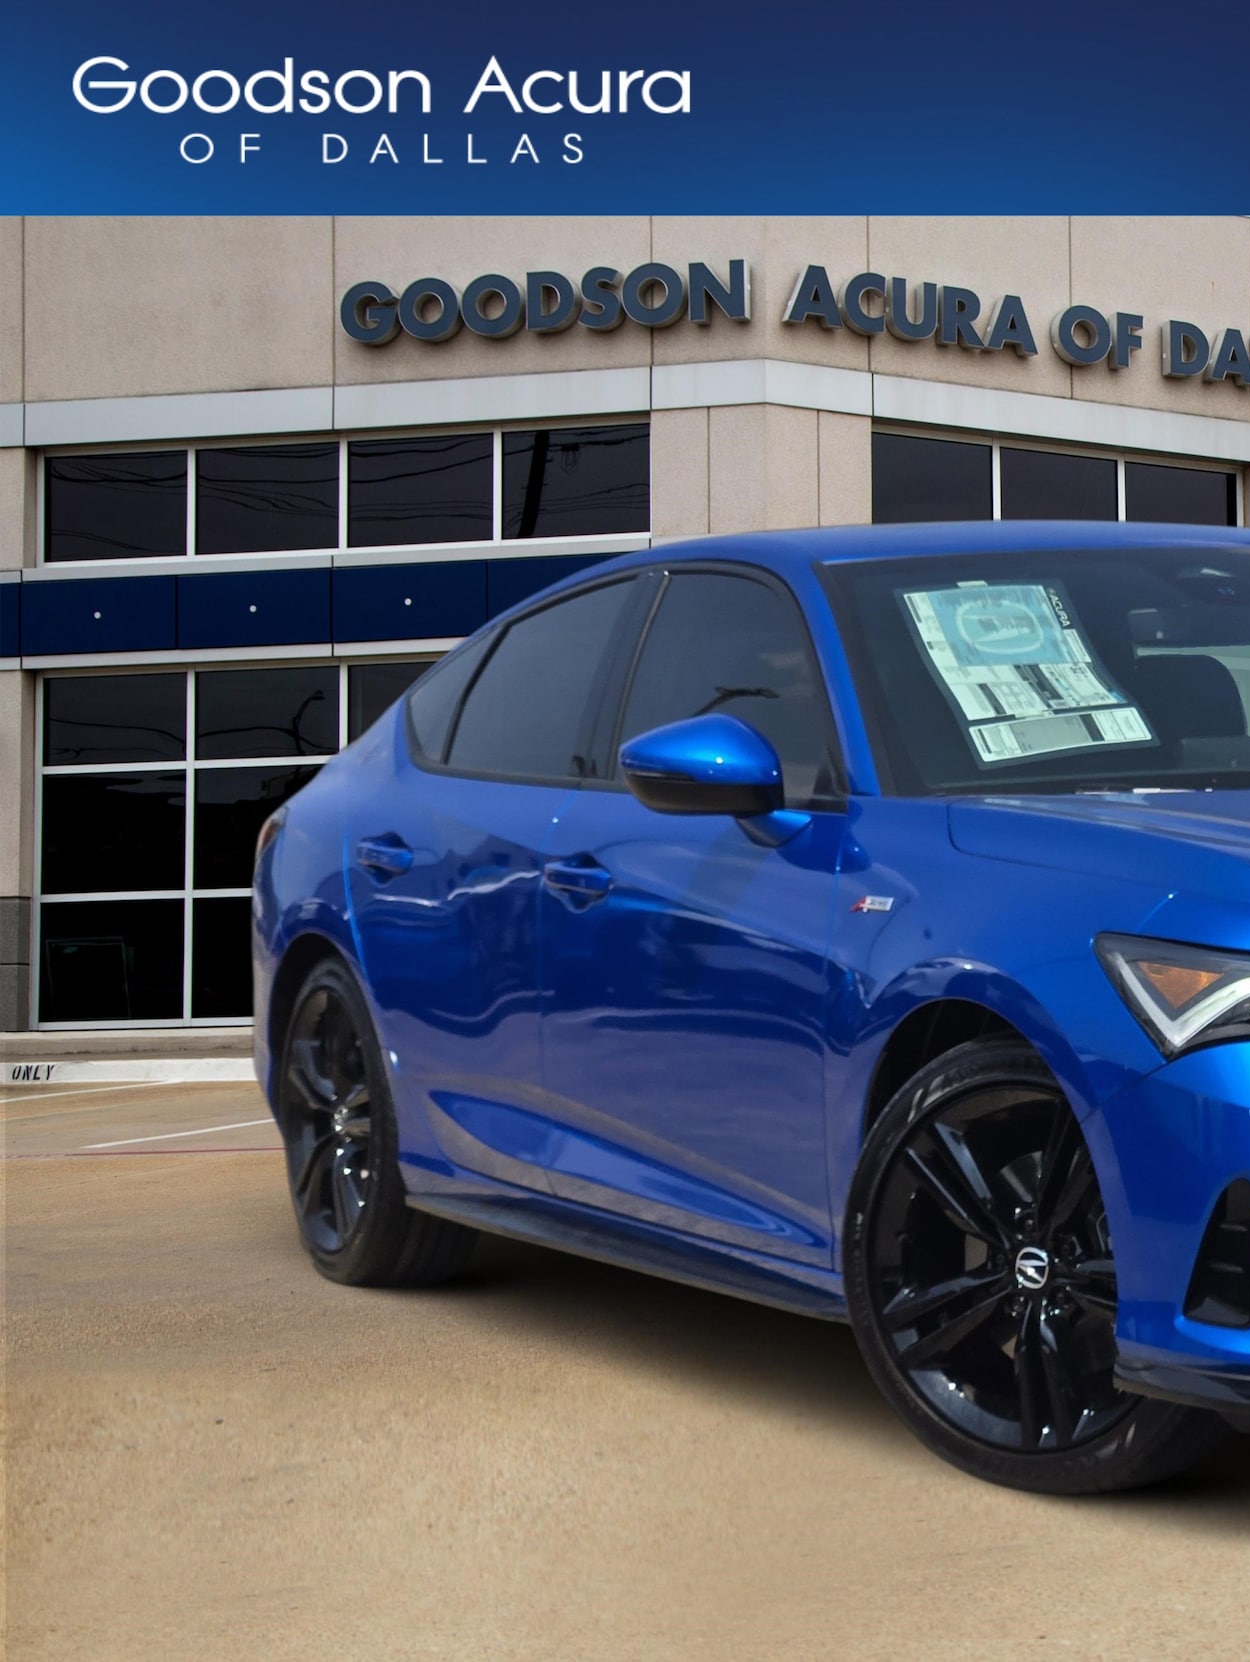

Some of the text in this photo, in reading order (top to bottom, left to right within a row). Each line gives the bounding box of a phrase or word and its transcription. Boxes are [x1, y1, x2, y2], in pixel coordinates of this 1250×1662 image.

[340, 258, 751, 347] GOODSON
[783, 264, 1038, 358] ACURA
[1051, 304, 1144, 371] OF
[1049, 594, 1071, 628] ACURA
[11, 1064, 56, 1081] ONLY
